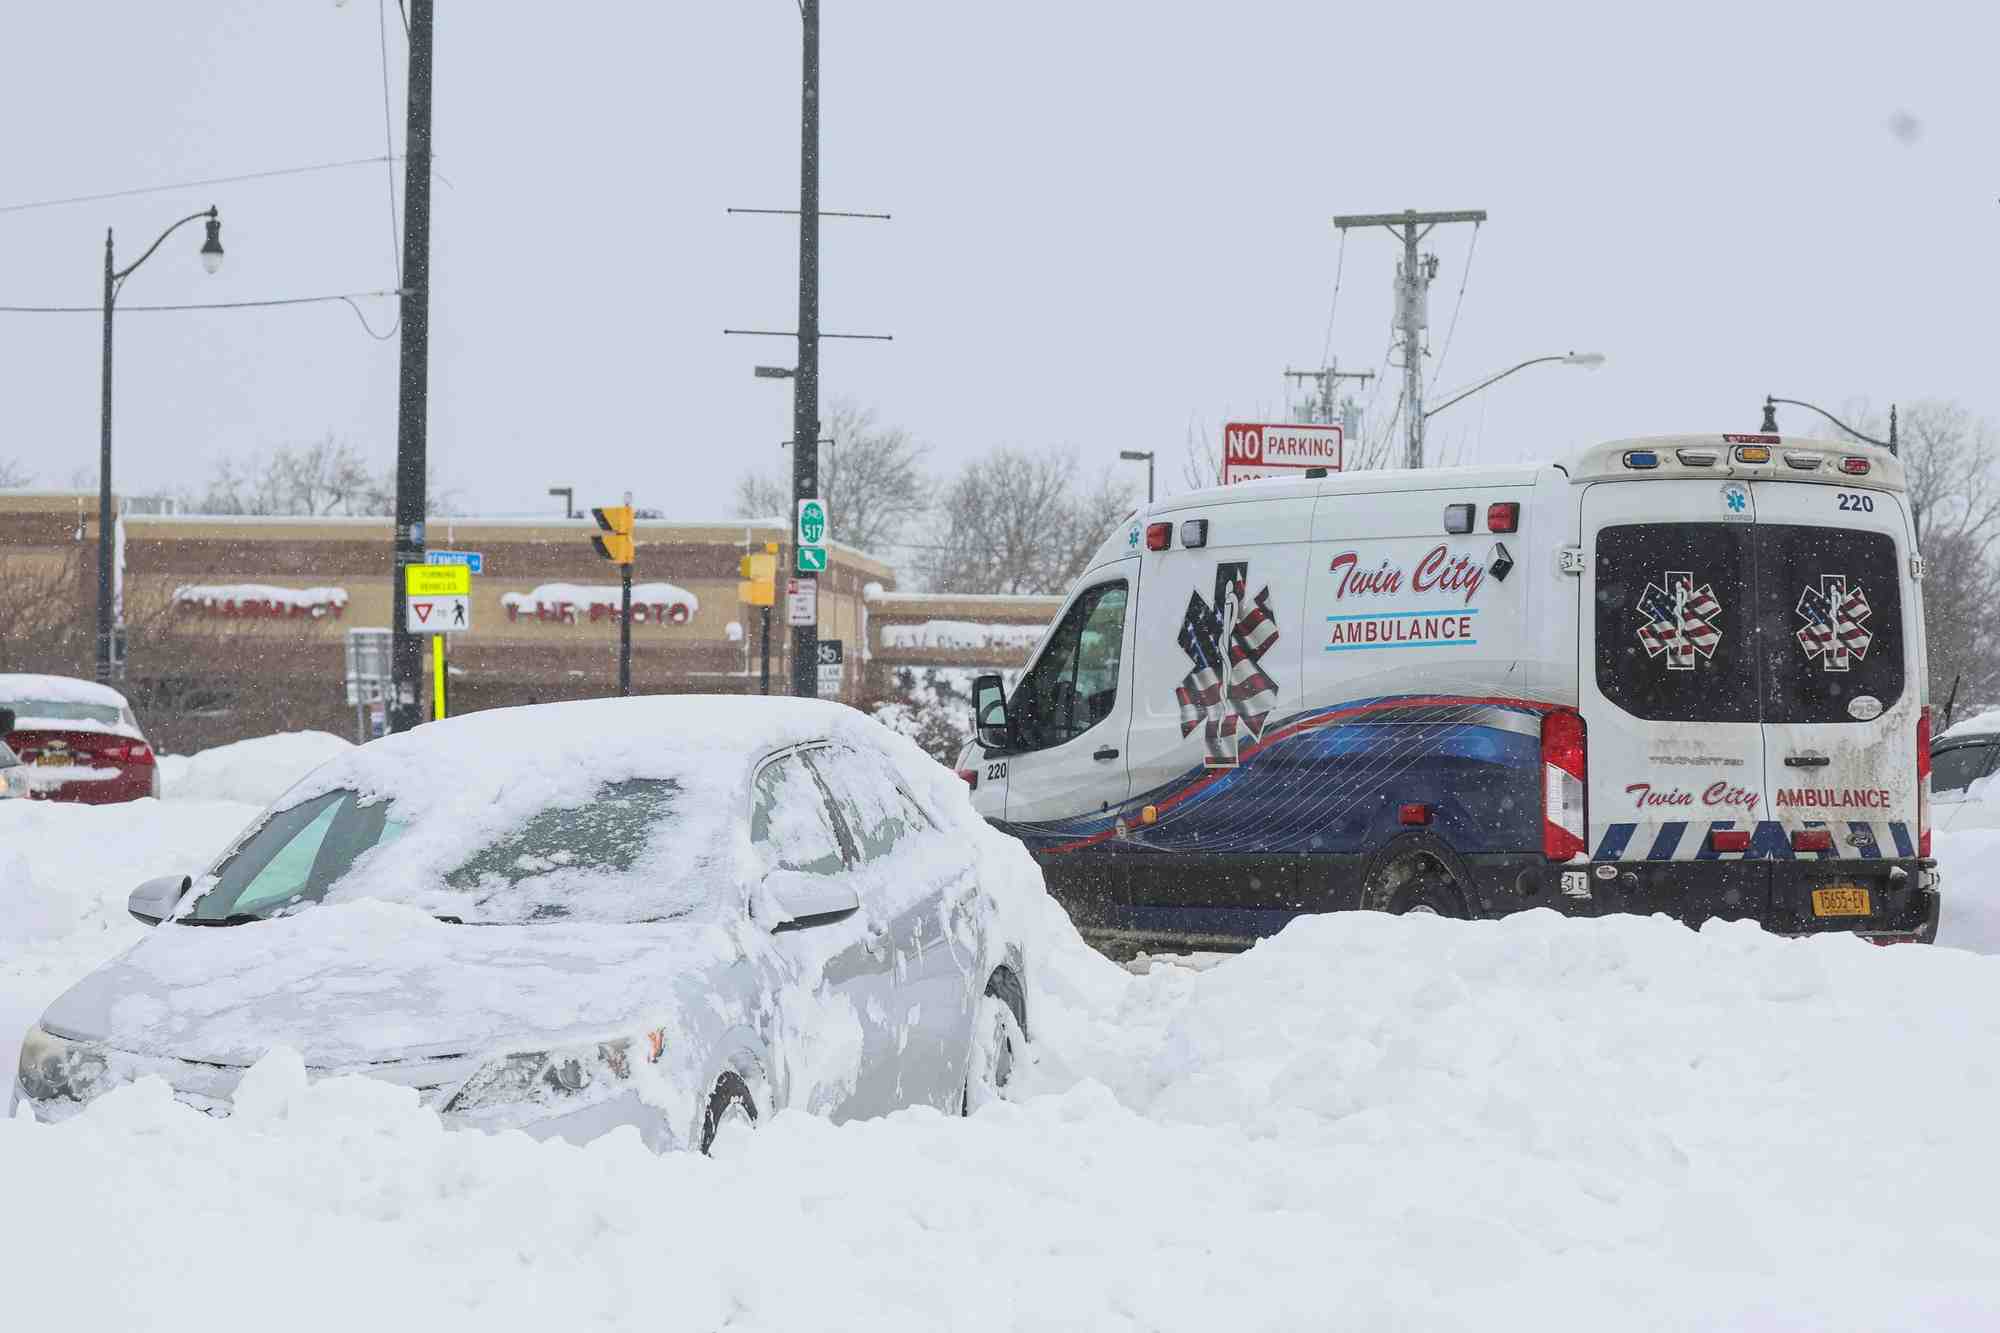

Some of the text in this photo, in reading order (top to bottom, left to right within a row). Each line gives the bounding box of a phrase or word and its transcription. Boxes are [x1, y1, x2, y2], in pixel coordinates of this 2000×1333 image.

[1228, 430, 1334, 460] NO PARKING
[1837, 492, 1874, 513] 220
[805, 524, 823, 539] 517
[1330, 544, 1484, 604] Twin City
[1331, 616, 1472, 644] AMBULANCE
[987, 762, 1007, 780] 220
[1625, 781, 1760, 812] Twin City
[1776, 788, 1890, 808] AMBULANCE
